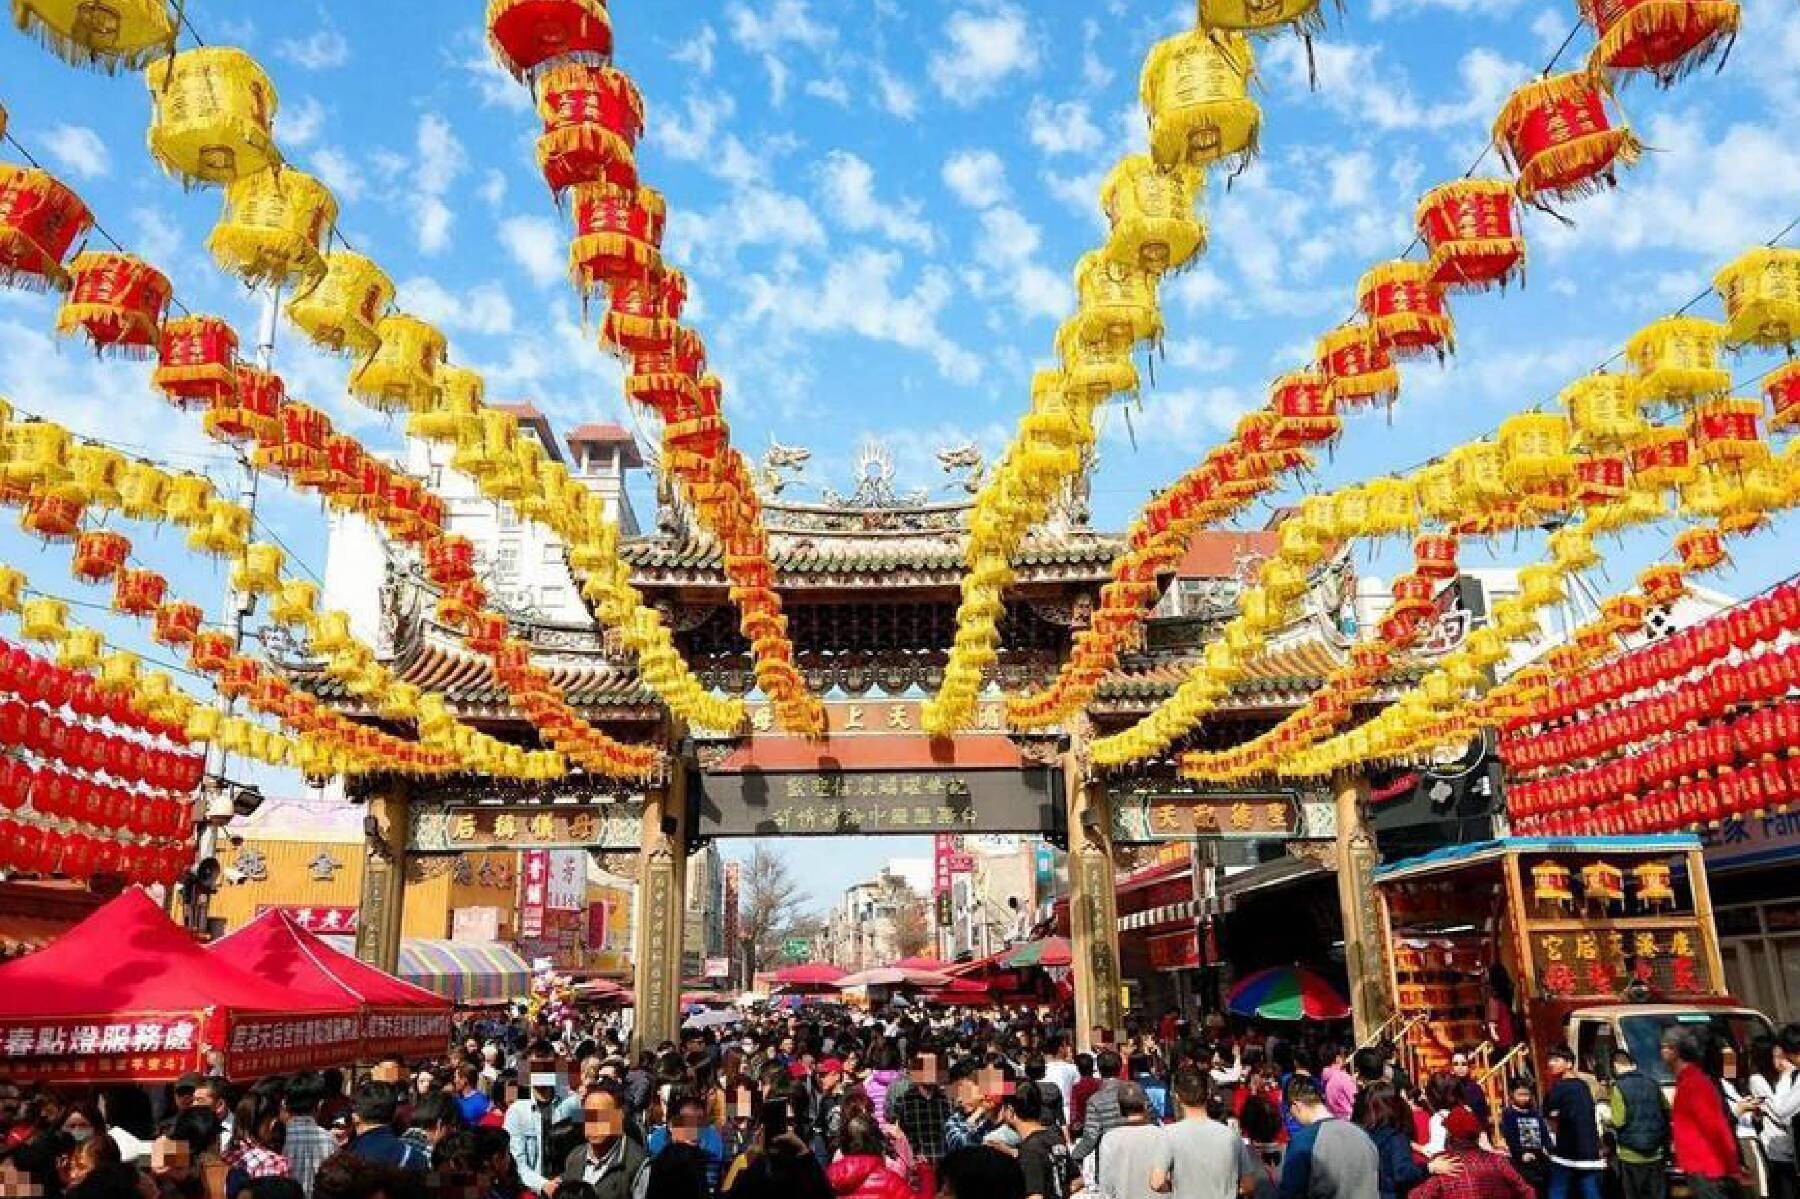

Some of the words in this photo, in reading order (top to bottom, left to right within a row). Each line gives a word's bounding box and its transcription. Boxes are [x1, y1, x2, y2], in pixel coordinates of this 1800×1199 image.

[0, 1021, 193, 1056] 春點燈服務處
